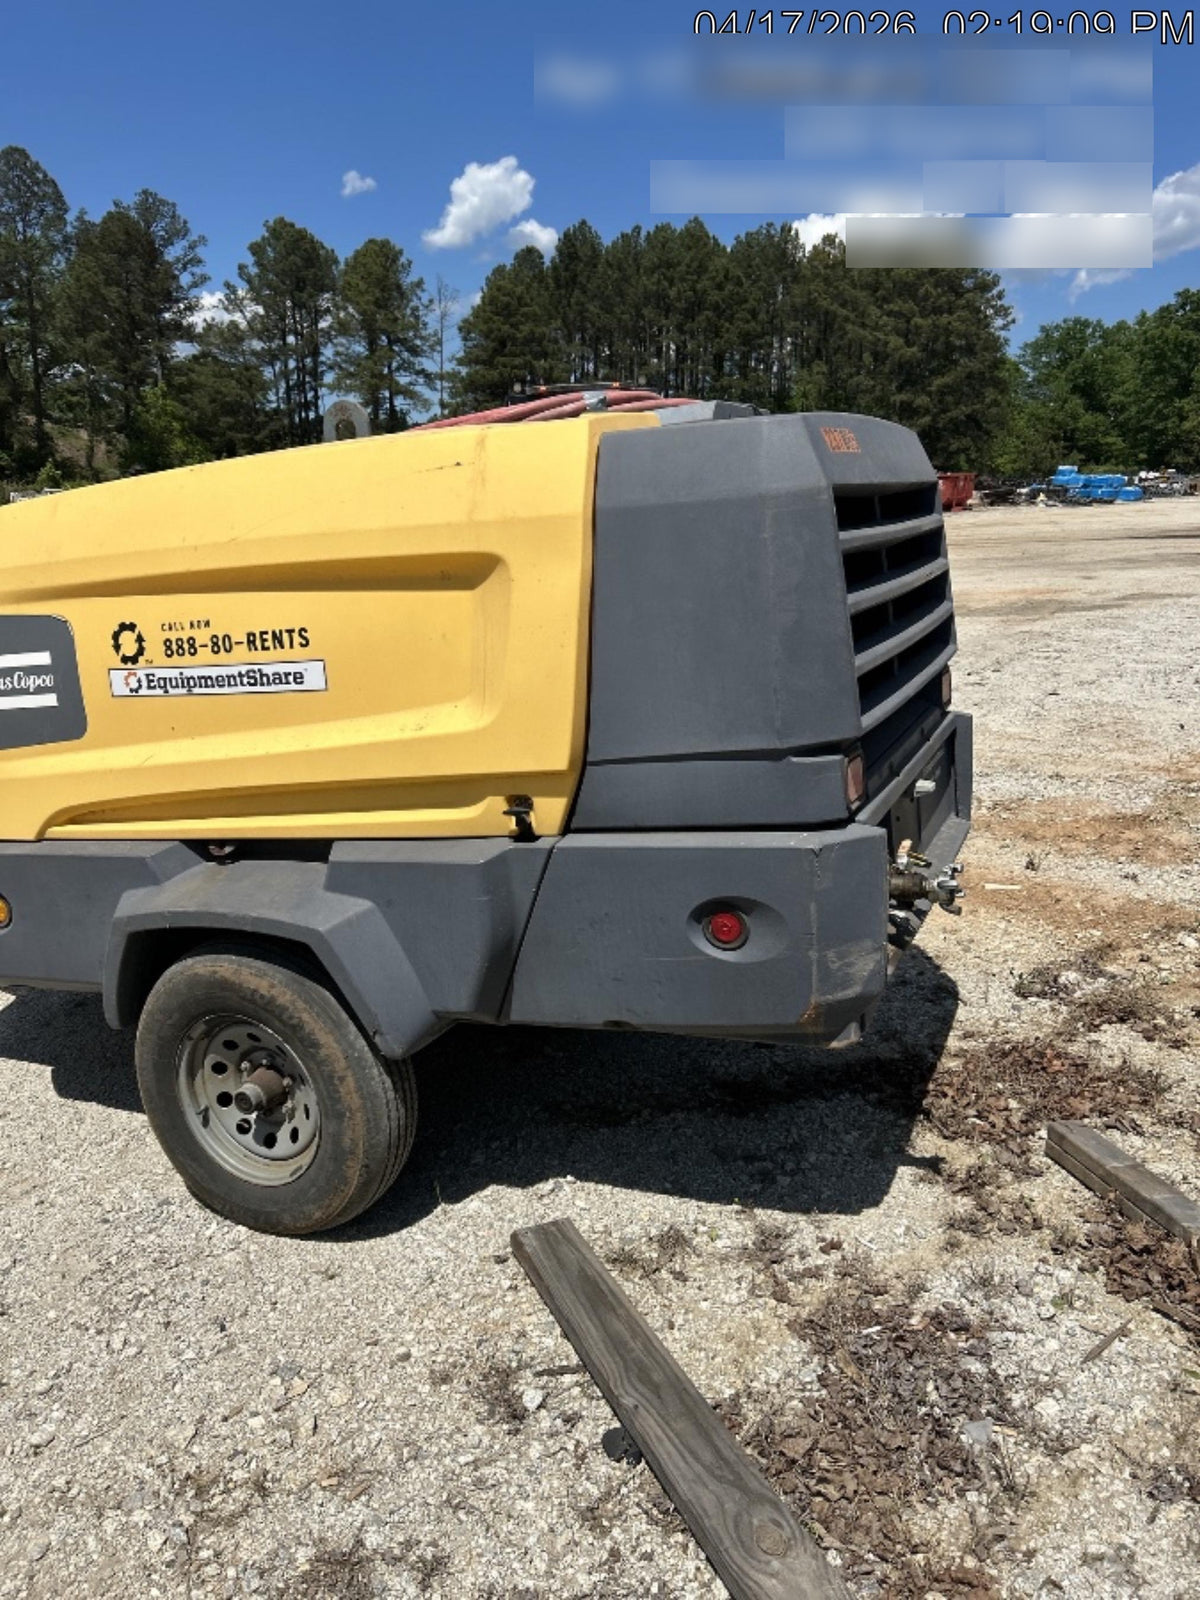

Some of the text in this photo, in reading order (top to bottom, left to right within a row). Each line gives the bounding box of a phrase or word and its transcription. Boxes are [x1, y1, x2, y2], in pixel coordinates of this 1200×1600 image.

[161, 619, 211, 632] CALL NOW
[163, 627, 310, 658] 888-80-RENTS
[14, 671, 54, 693] Copco
